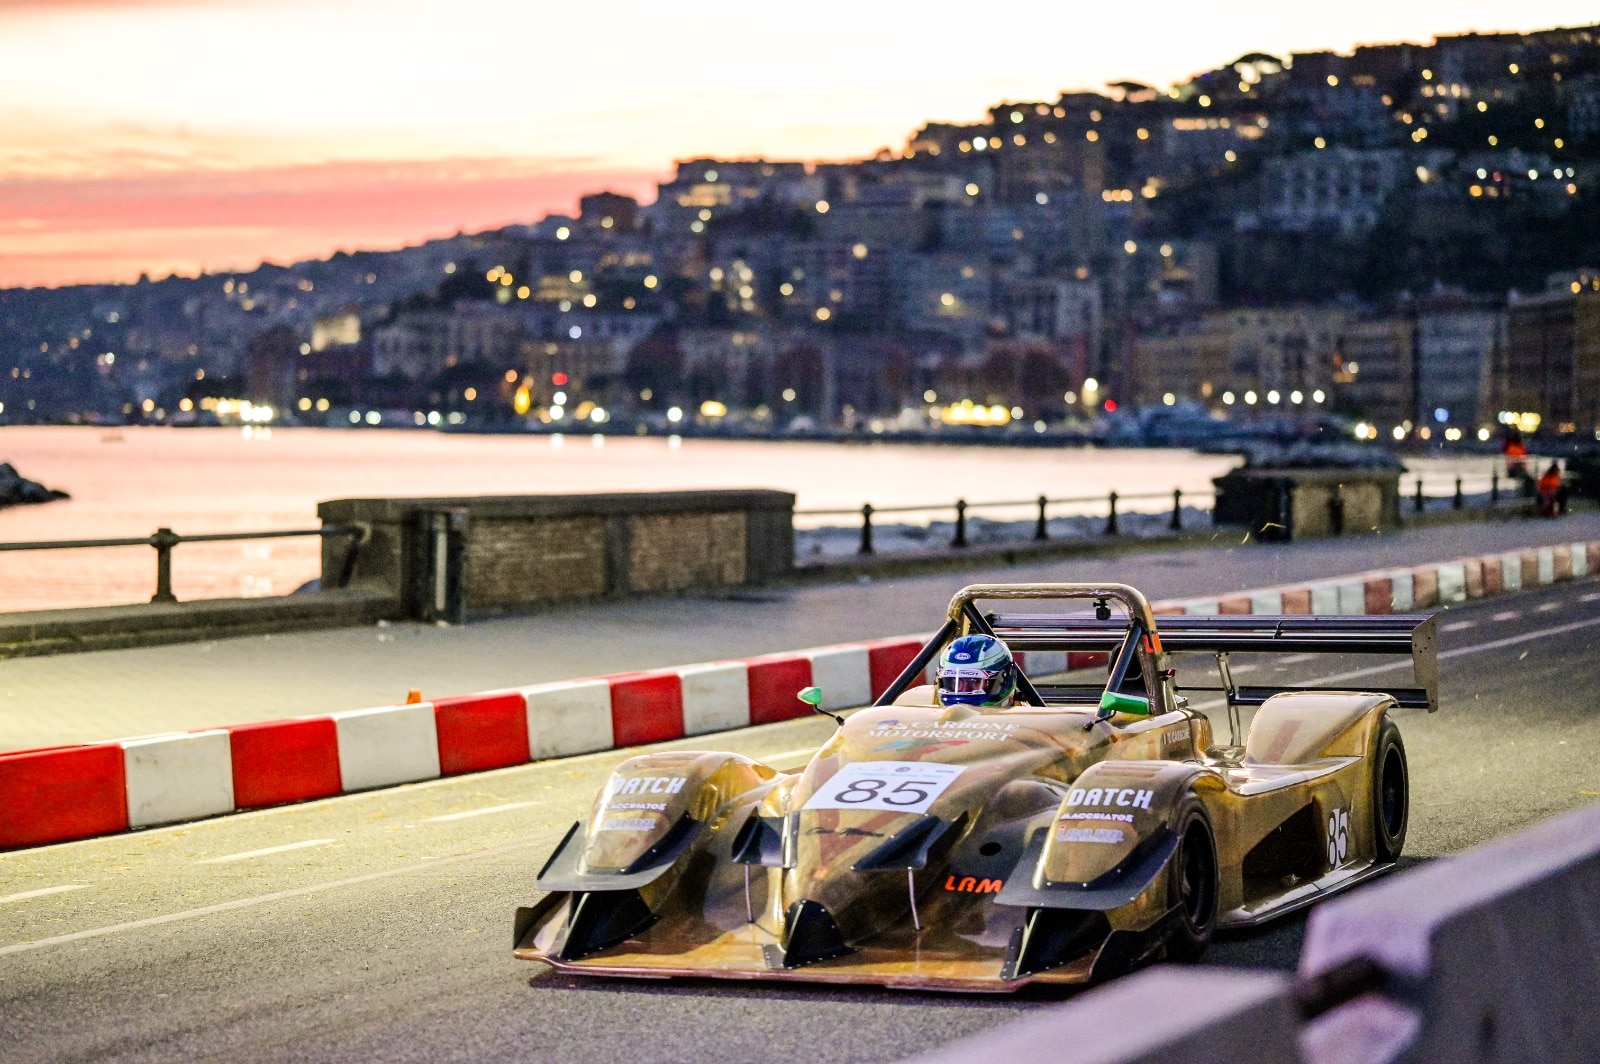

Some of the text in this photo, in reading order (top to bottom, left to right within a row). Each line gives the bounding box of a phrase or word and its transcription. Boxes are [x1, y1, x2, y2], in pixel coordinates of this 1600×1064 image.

[865, 729, 1014, 742] MOTORSPORT
[911, 720, 1020, 732] CARBONE
[834, 779, 937, 806] 85
[1067, 788, 1154, 809] DATCH
[1327, 807, 1349, 870] 85
